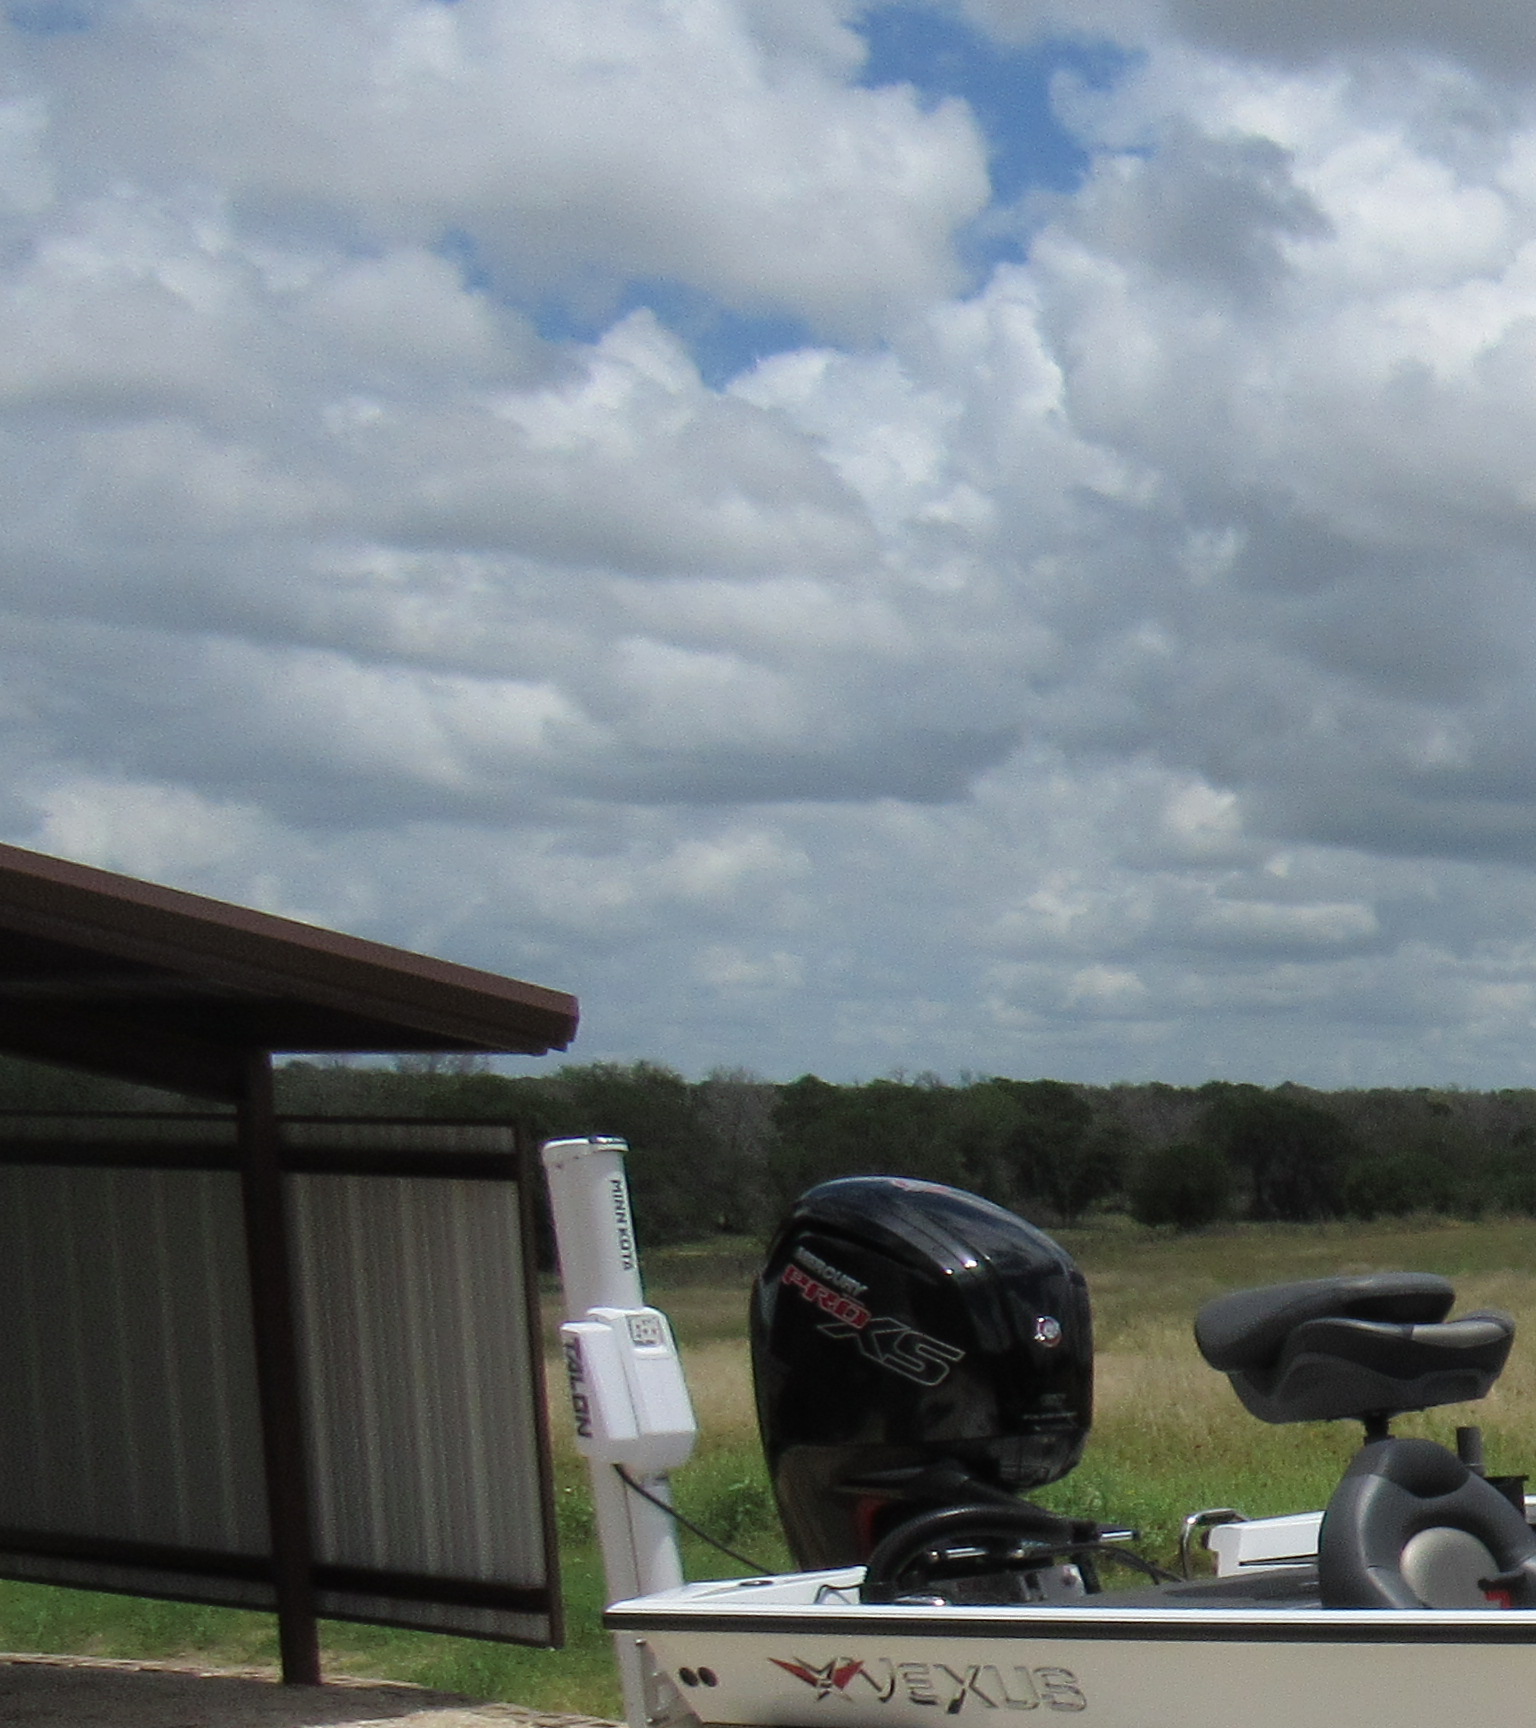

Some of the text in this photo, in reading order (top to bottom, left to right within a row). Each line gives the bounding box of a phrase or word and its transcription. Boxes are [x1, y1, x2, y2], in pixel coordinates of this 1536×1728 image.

[611, 1179, 634, 1271] MINN KOTA
[782, 1265, 872, 1330] PRO
[565, 1338, 593, 1439] TALON
[838, 1655, 1087, 1714] VEXUS
